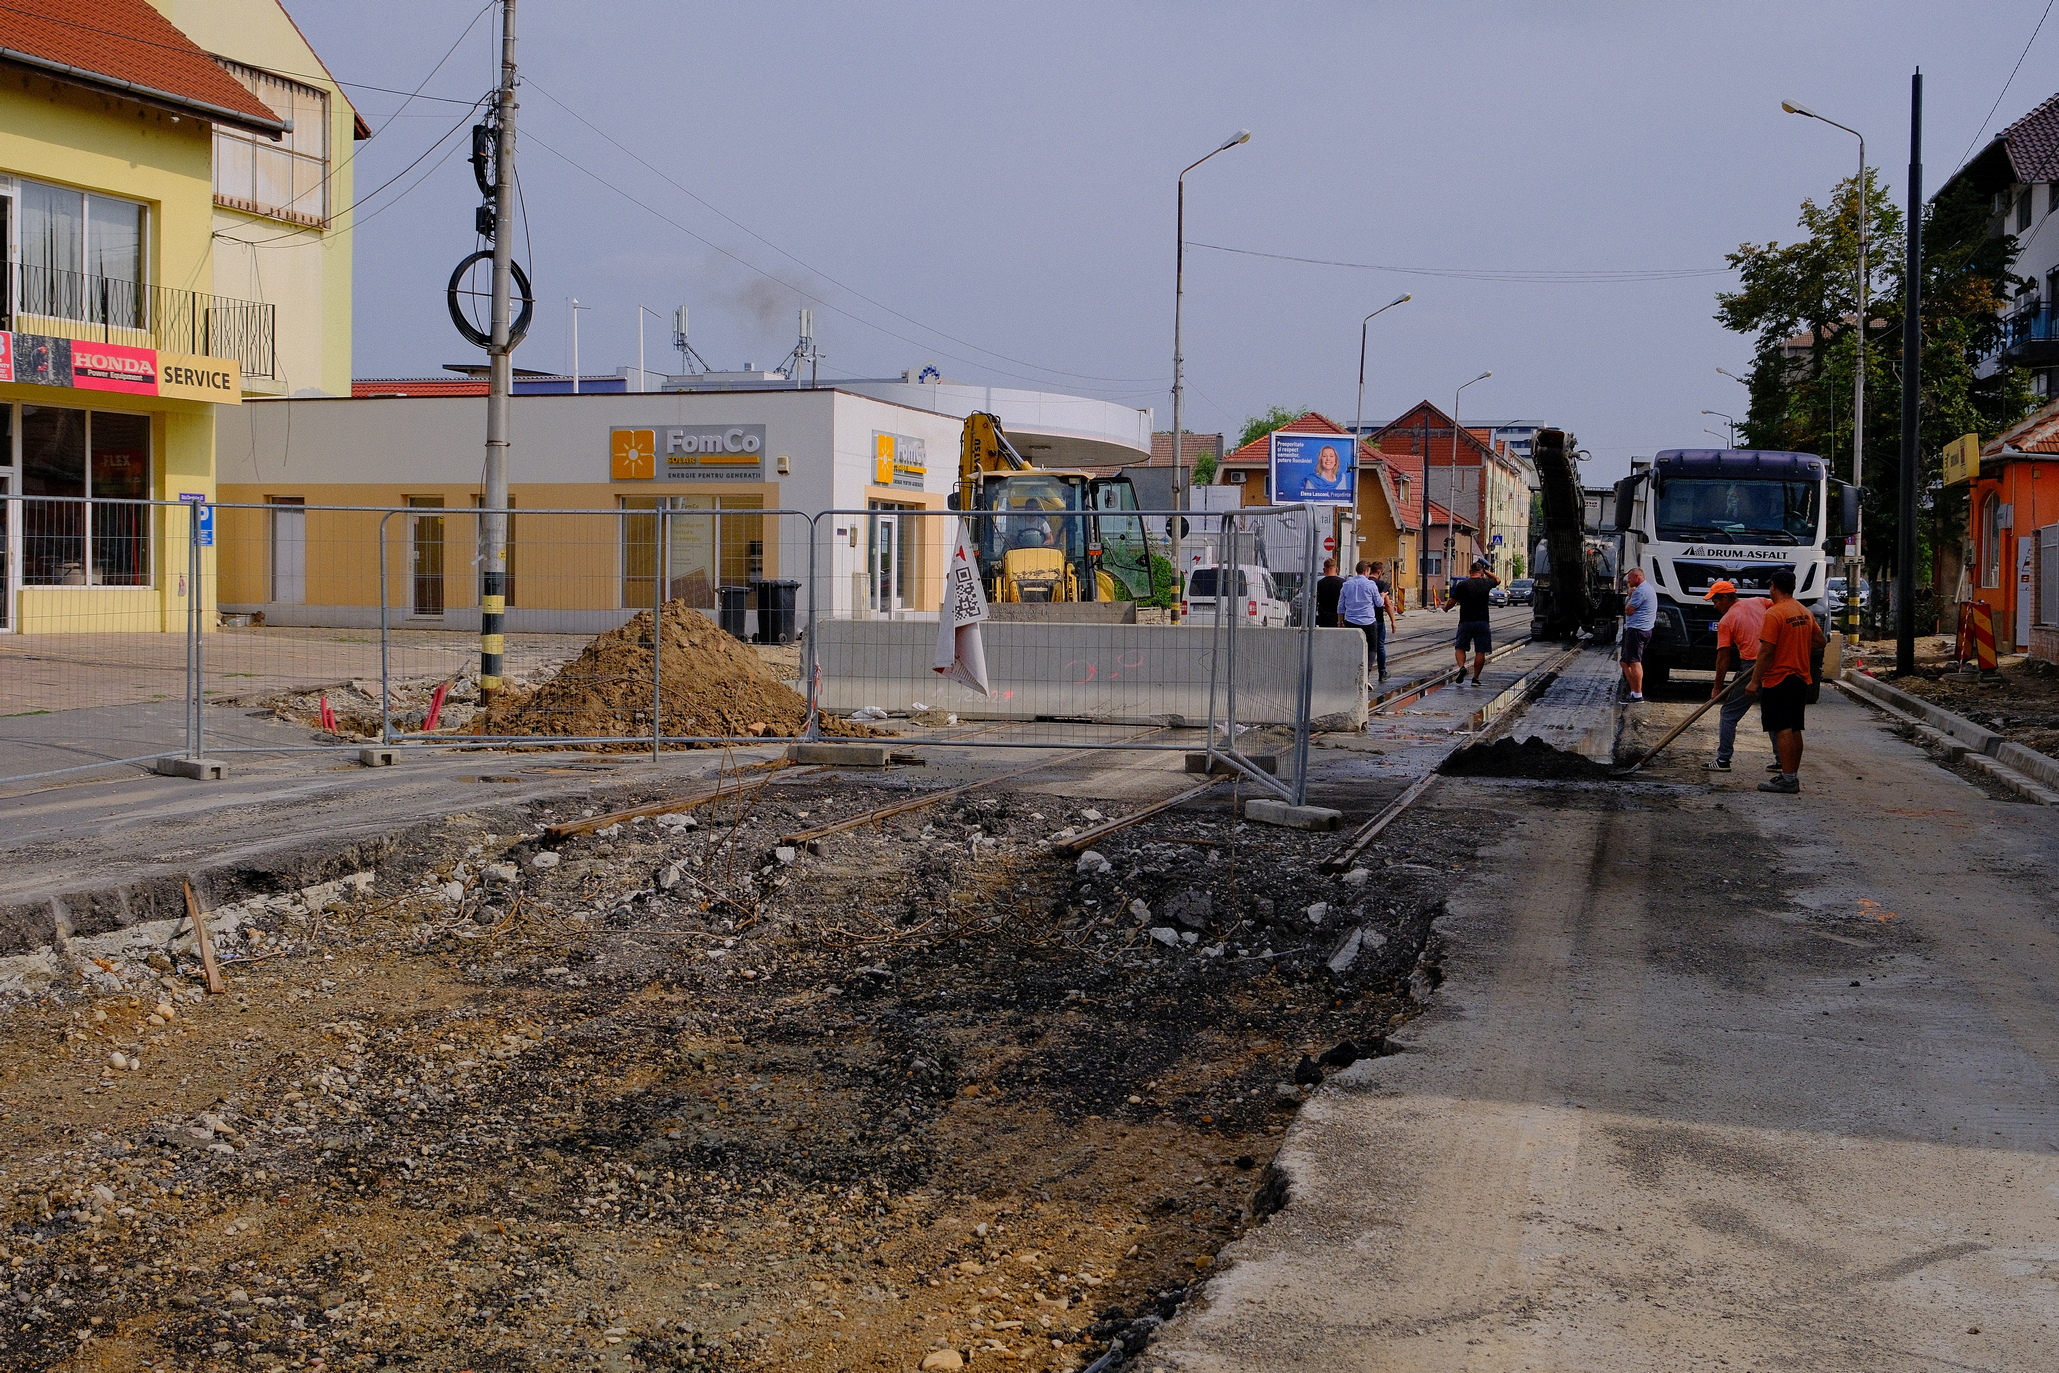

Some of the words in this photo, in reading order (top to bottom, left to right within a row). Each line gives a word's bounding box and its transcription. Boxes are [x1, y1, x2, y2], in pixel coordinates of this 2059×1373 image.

[73, 352, 155, 375] HONDA
[87, 369, 109, 378] Power
[110, 371, 144, 382] Equipment
[164, 366, 231, 390] SERVICE
[666, 428, 761, 454] FomCo
[103, 454, 131, 467] FLEX
[667, 456, 697, 465] SOLAR
[1707, 548, 1788, 560] DRUM-ASFALT
[1707, 577, 1759, 589] MAN
